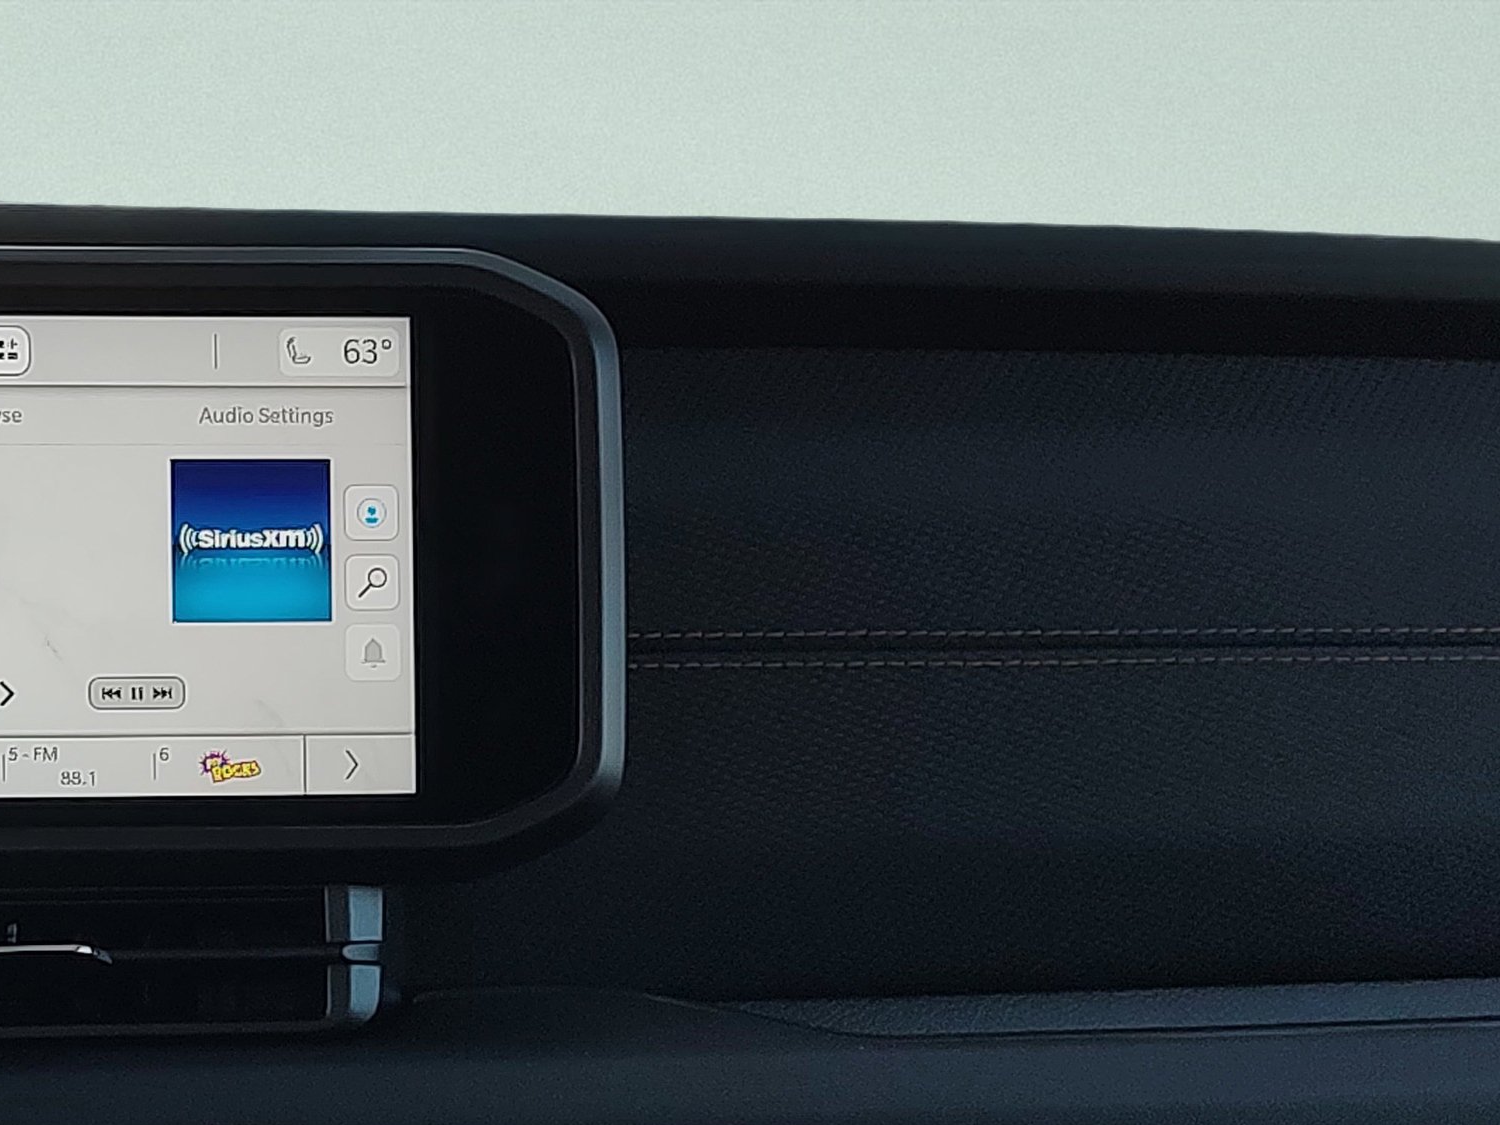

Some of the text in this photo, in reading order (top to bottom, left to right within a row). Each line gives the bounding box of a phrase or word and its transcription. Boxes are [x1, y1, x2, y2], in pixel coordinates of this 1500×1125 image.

[343, 339, 392, 364] 63°
[199, 406, 334, 427] Audio Settings
[8, 747, 18, 761] 5
[33, 747, 58, 761] FM
[159, 747, 169, 761] 6
